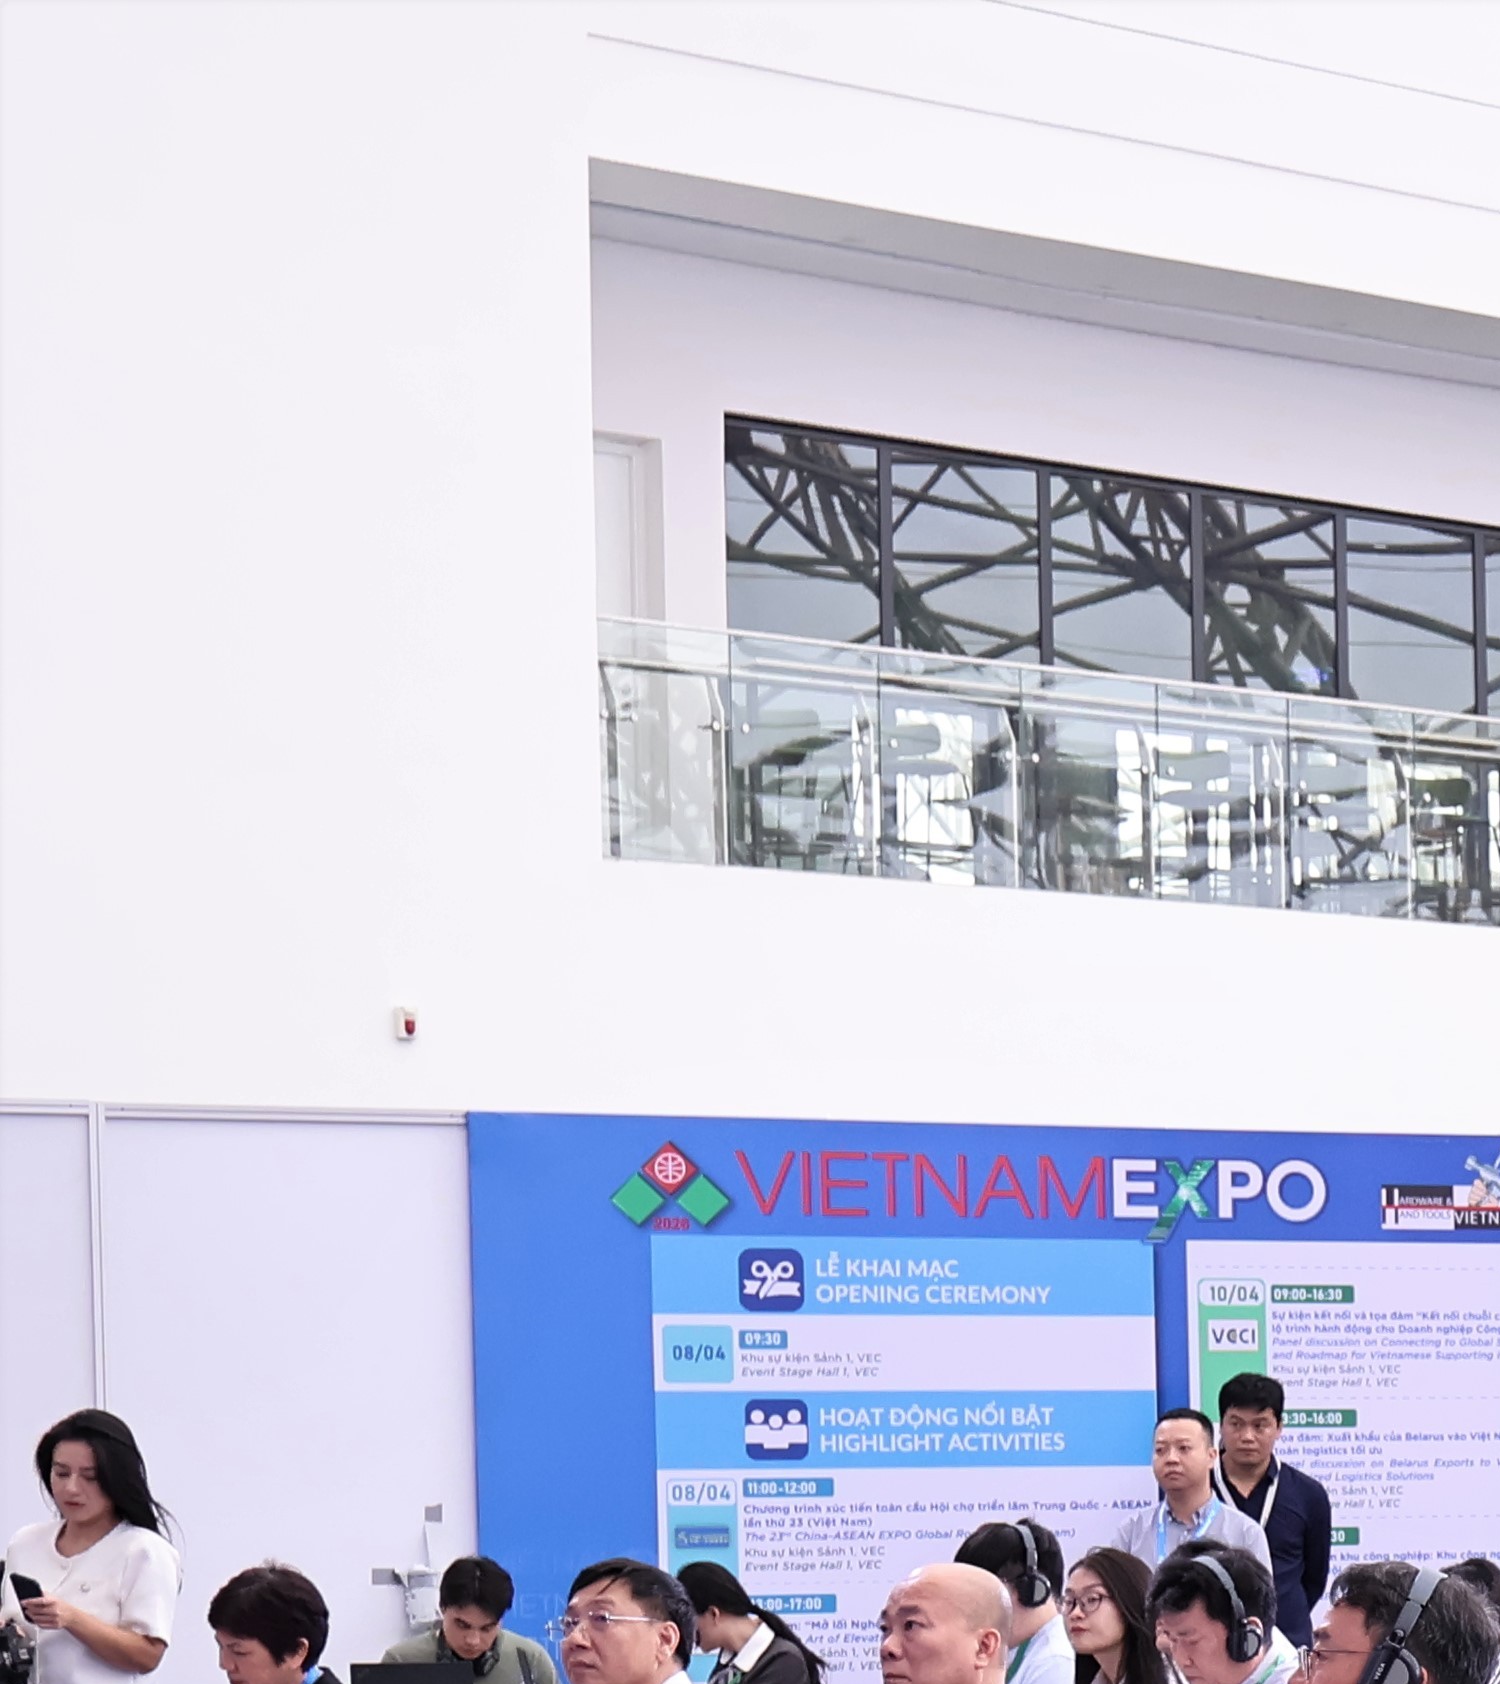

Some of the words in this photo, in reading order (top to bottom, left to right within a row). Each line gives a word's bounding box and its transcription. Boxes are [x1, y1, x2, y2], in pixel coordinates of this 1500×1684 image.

[815, 1251, 840, 1278] LỄ
[847, 1259, 901, 1277] KHAI
[908, 1259, 959, 1283] MẠC
[815, 1285, 920, 1304] OPENING
[925, 1285, 1051, 1305] CEREMONY
[1210, 1285, 1259, 1305] 10/04
[1273, 1287, 1343, 1301] 09:00-16:30
[672, 1344, 726, 1364] 08/04
[741, 1366, 775, 1377] Event
[779, 1366, 813, 1379] Stage
[817, 1366, 840, 1377] Hall
[855, 1366, 880, 1377] VEC
[819, 1408, 884, 1430] HOẠT
[888, 1403, 958, 1430] ĐỘNG
[964, 1400, 1005, 1426] NỔI
[1011, 1403, 1054, 1429] BẬT
[1283, 1412, 1342, 1425] 3:30-16:00
[820, 1433, 944, 1453] HIGHLIGHT
[948, 1432, 1066, 1452] ACTIVITIES
[672, 1482, 731, 1504] 08/04
